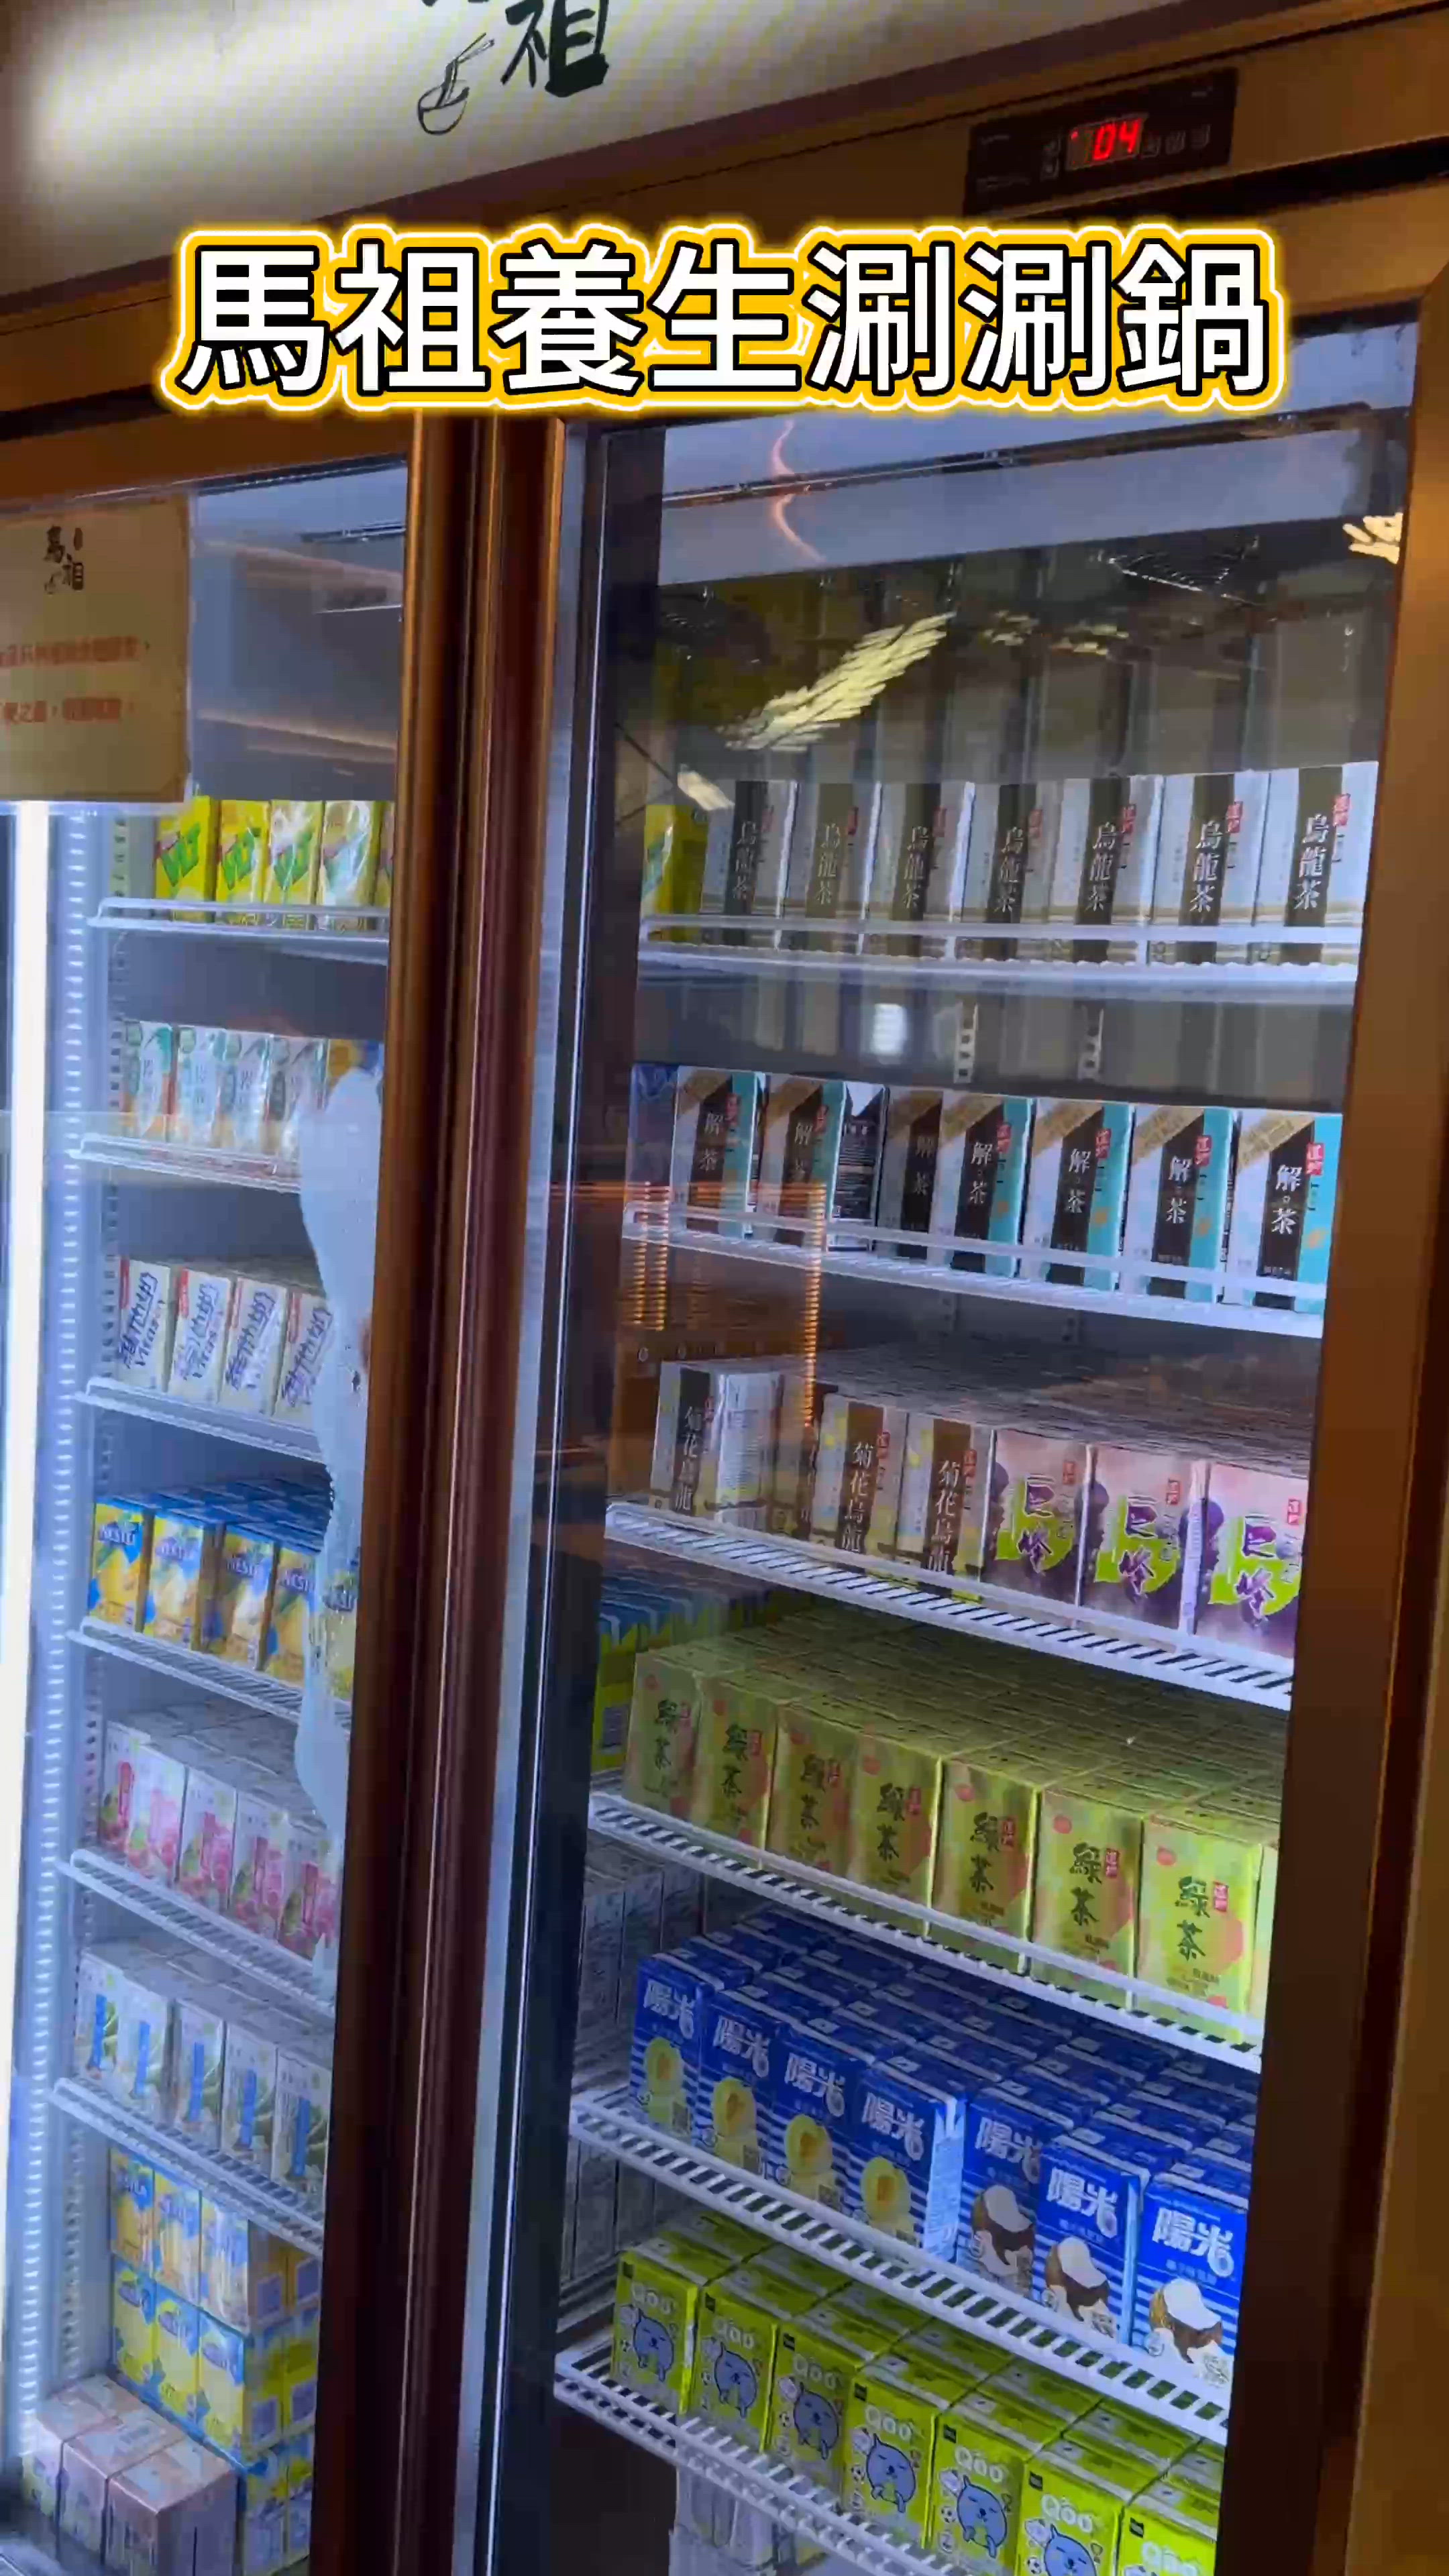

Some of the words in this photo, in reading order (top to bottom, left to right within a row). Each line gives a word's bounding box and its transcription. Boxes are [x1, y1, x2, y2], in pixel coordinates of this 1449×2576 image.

[1093, 117, 1142, 161] 04
[1189, 820, 1223, 913] 烏龍茶
[1294, 813, 1330, 911] 烏龍茶
[1069, 1842, 1102, 1926] 綠茶
[1175, 1876, 1211, 1962] 綠茶
[1046, 2166, 1118, 2239] 陽光
[1151, 2207, 1235, 2277] 陽光
